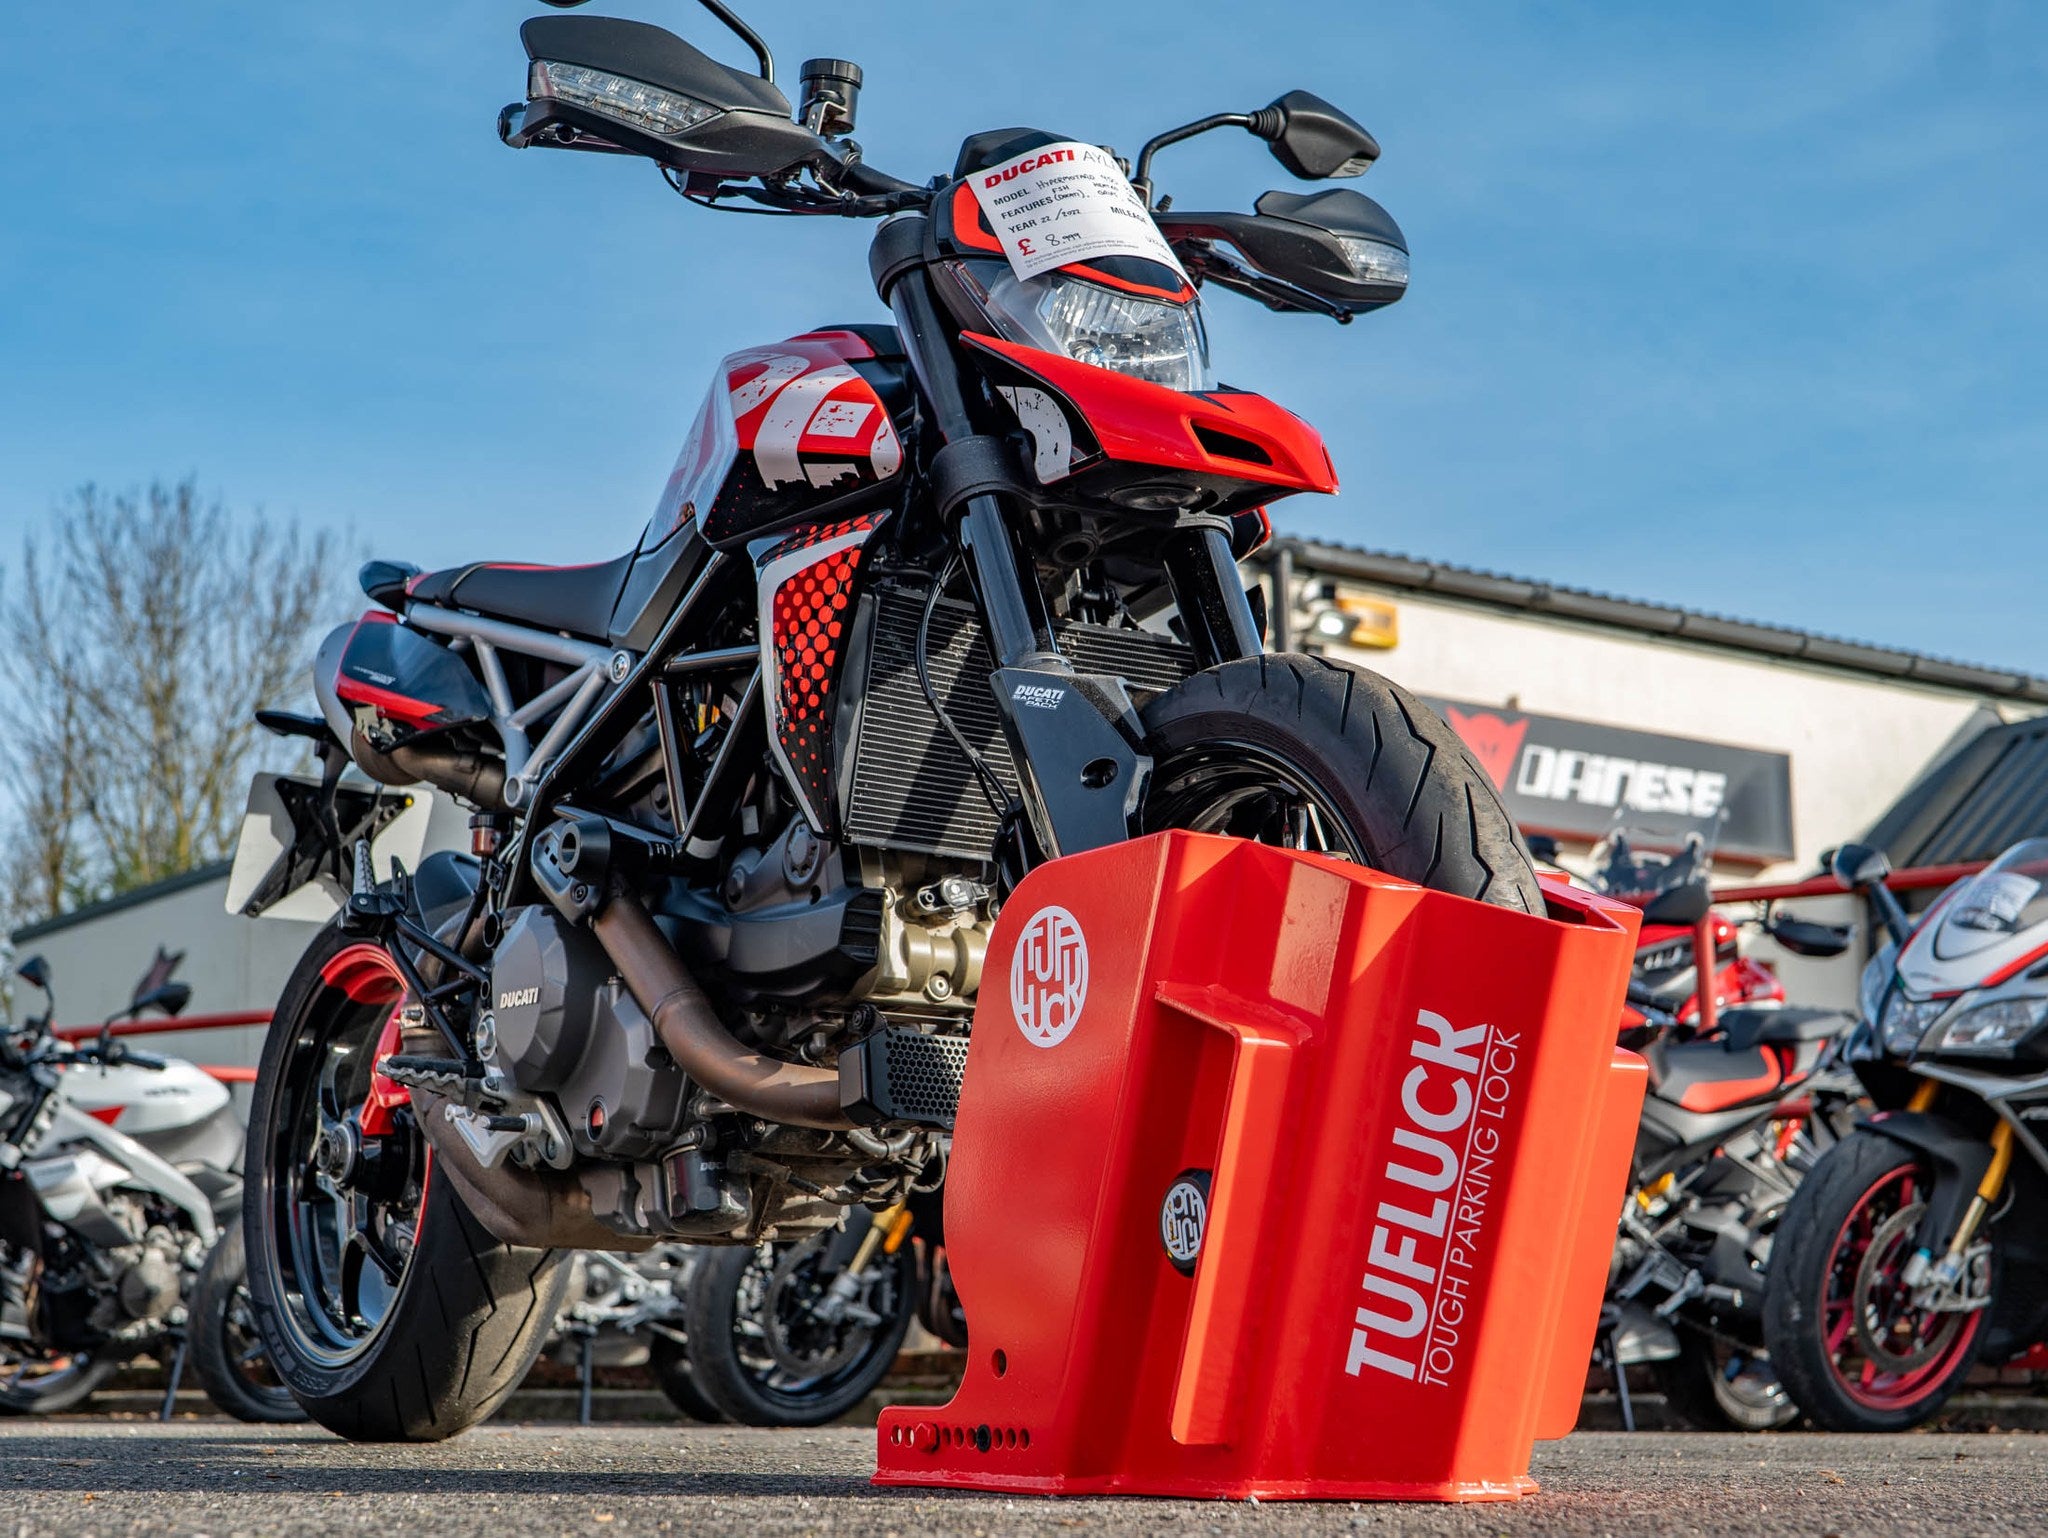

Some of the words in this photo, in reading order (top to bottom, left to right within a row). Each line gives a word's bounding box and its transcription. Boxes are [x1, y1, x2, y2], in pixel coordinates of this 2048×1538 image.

[985, 150, 1074, 189] DUCATI
[993, 189, 1030, 206] MODEL
[1000, 196, 1053, 220] FEATURES
[1008, 219, 1037, 234] YEAR
[1017, 238, 1036, 256] £
[1014, 685, 1065, 700] DUCATI
[1025, 700, 1058, 709] PACK
[500, 986, 540, 1009] DUCATI
[1345, 1008, 1488, 1381] TUFLUCK
[1424, 1275, 1470, 1387] TOUGH
[1450, 1127, 1499, 1269] PARKING
[1480, 1027, 1521, 1120] LOCK
